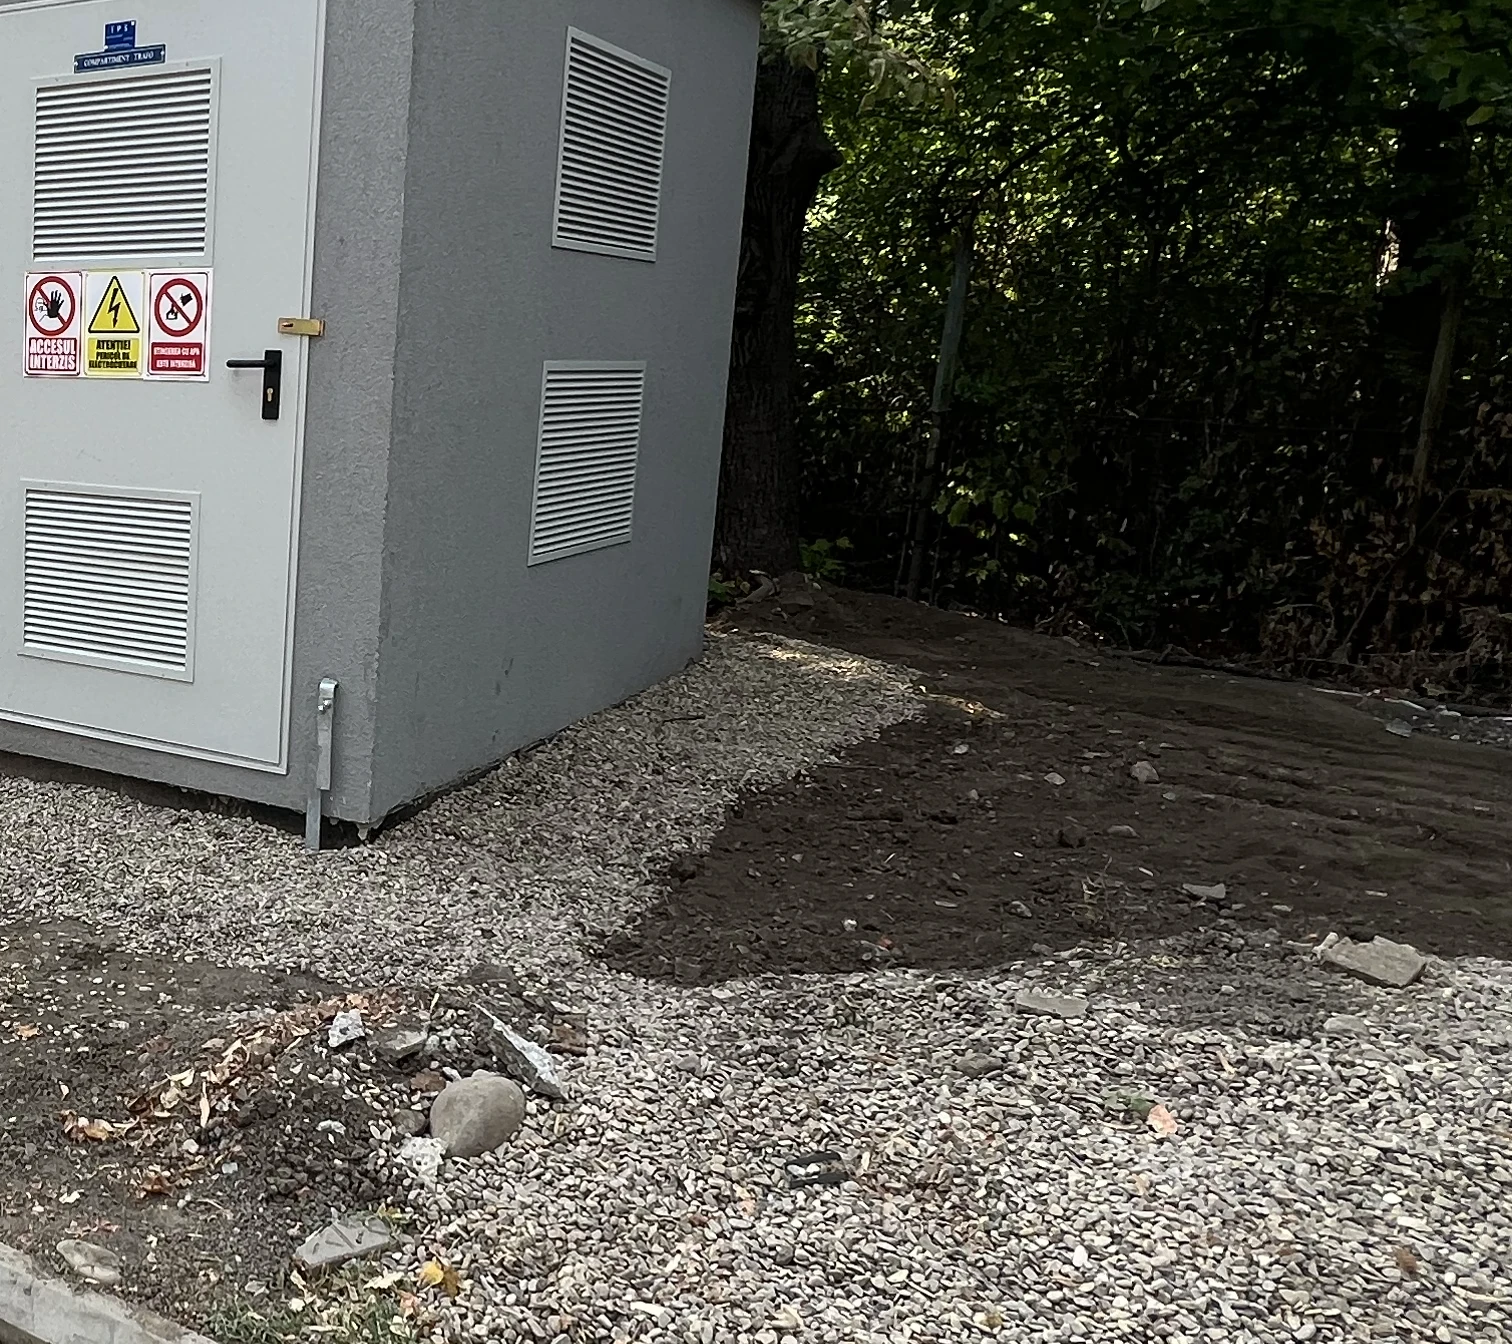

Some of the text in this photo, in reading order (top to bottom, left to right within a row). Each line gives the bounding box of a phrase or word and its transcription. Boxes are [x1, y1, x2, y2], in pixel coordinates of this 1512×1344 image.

[83, 51, 155, 68] COMPARTIMENT TRAFO
[29, 339, 76, 355] ACCESUL
[29, 354, 76, 370] INTERZIS
